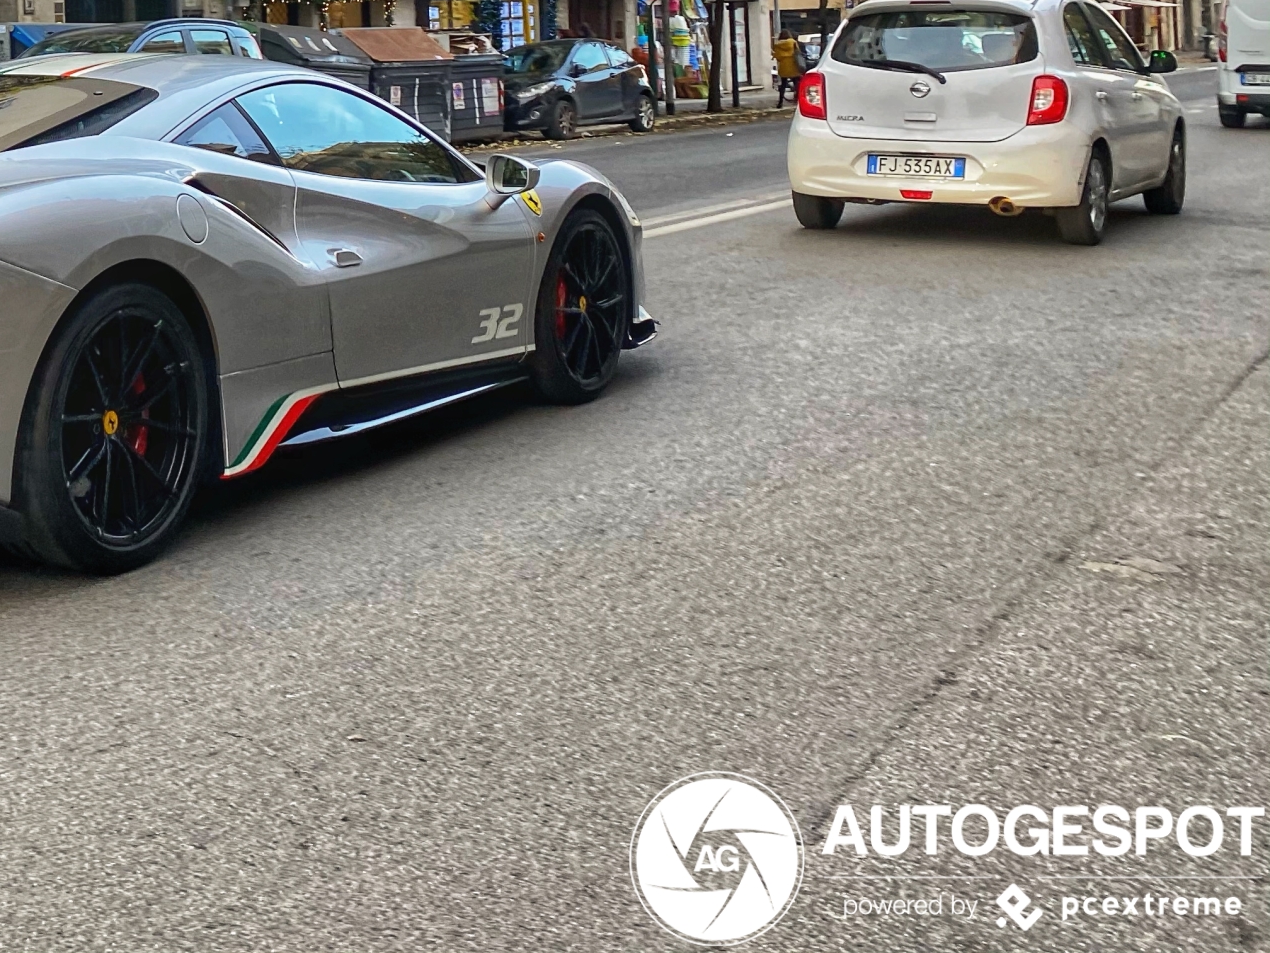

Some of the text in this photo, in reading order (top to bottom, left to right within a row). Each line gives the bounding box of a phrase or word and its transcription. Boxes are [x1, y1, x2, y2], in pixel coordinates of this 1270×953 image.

[879, 157, 898, 172] FJ
[903, 158, 953, 175] 535AX
[471, 302, 524, 344] 32
